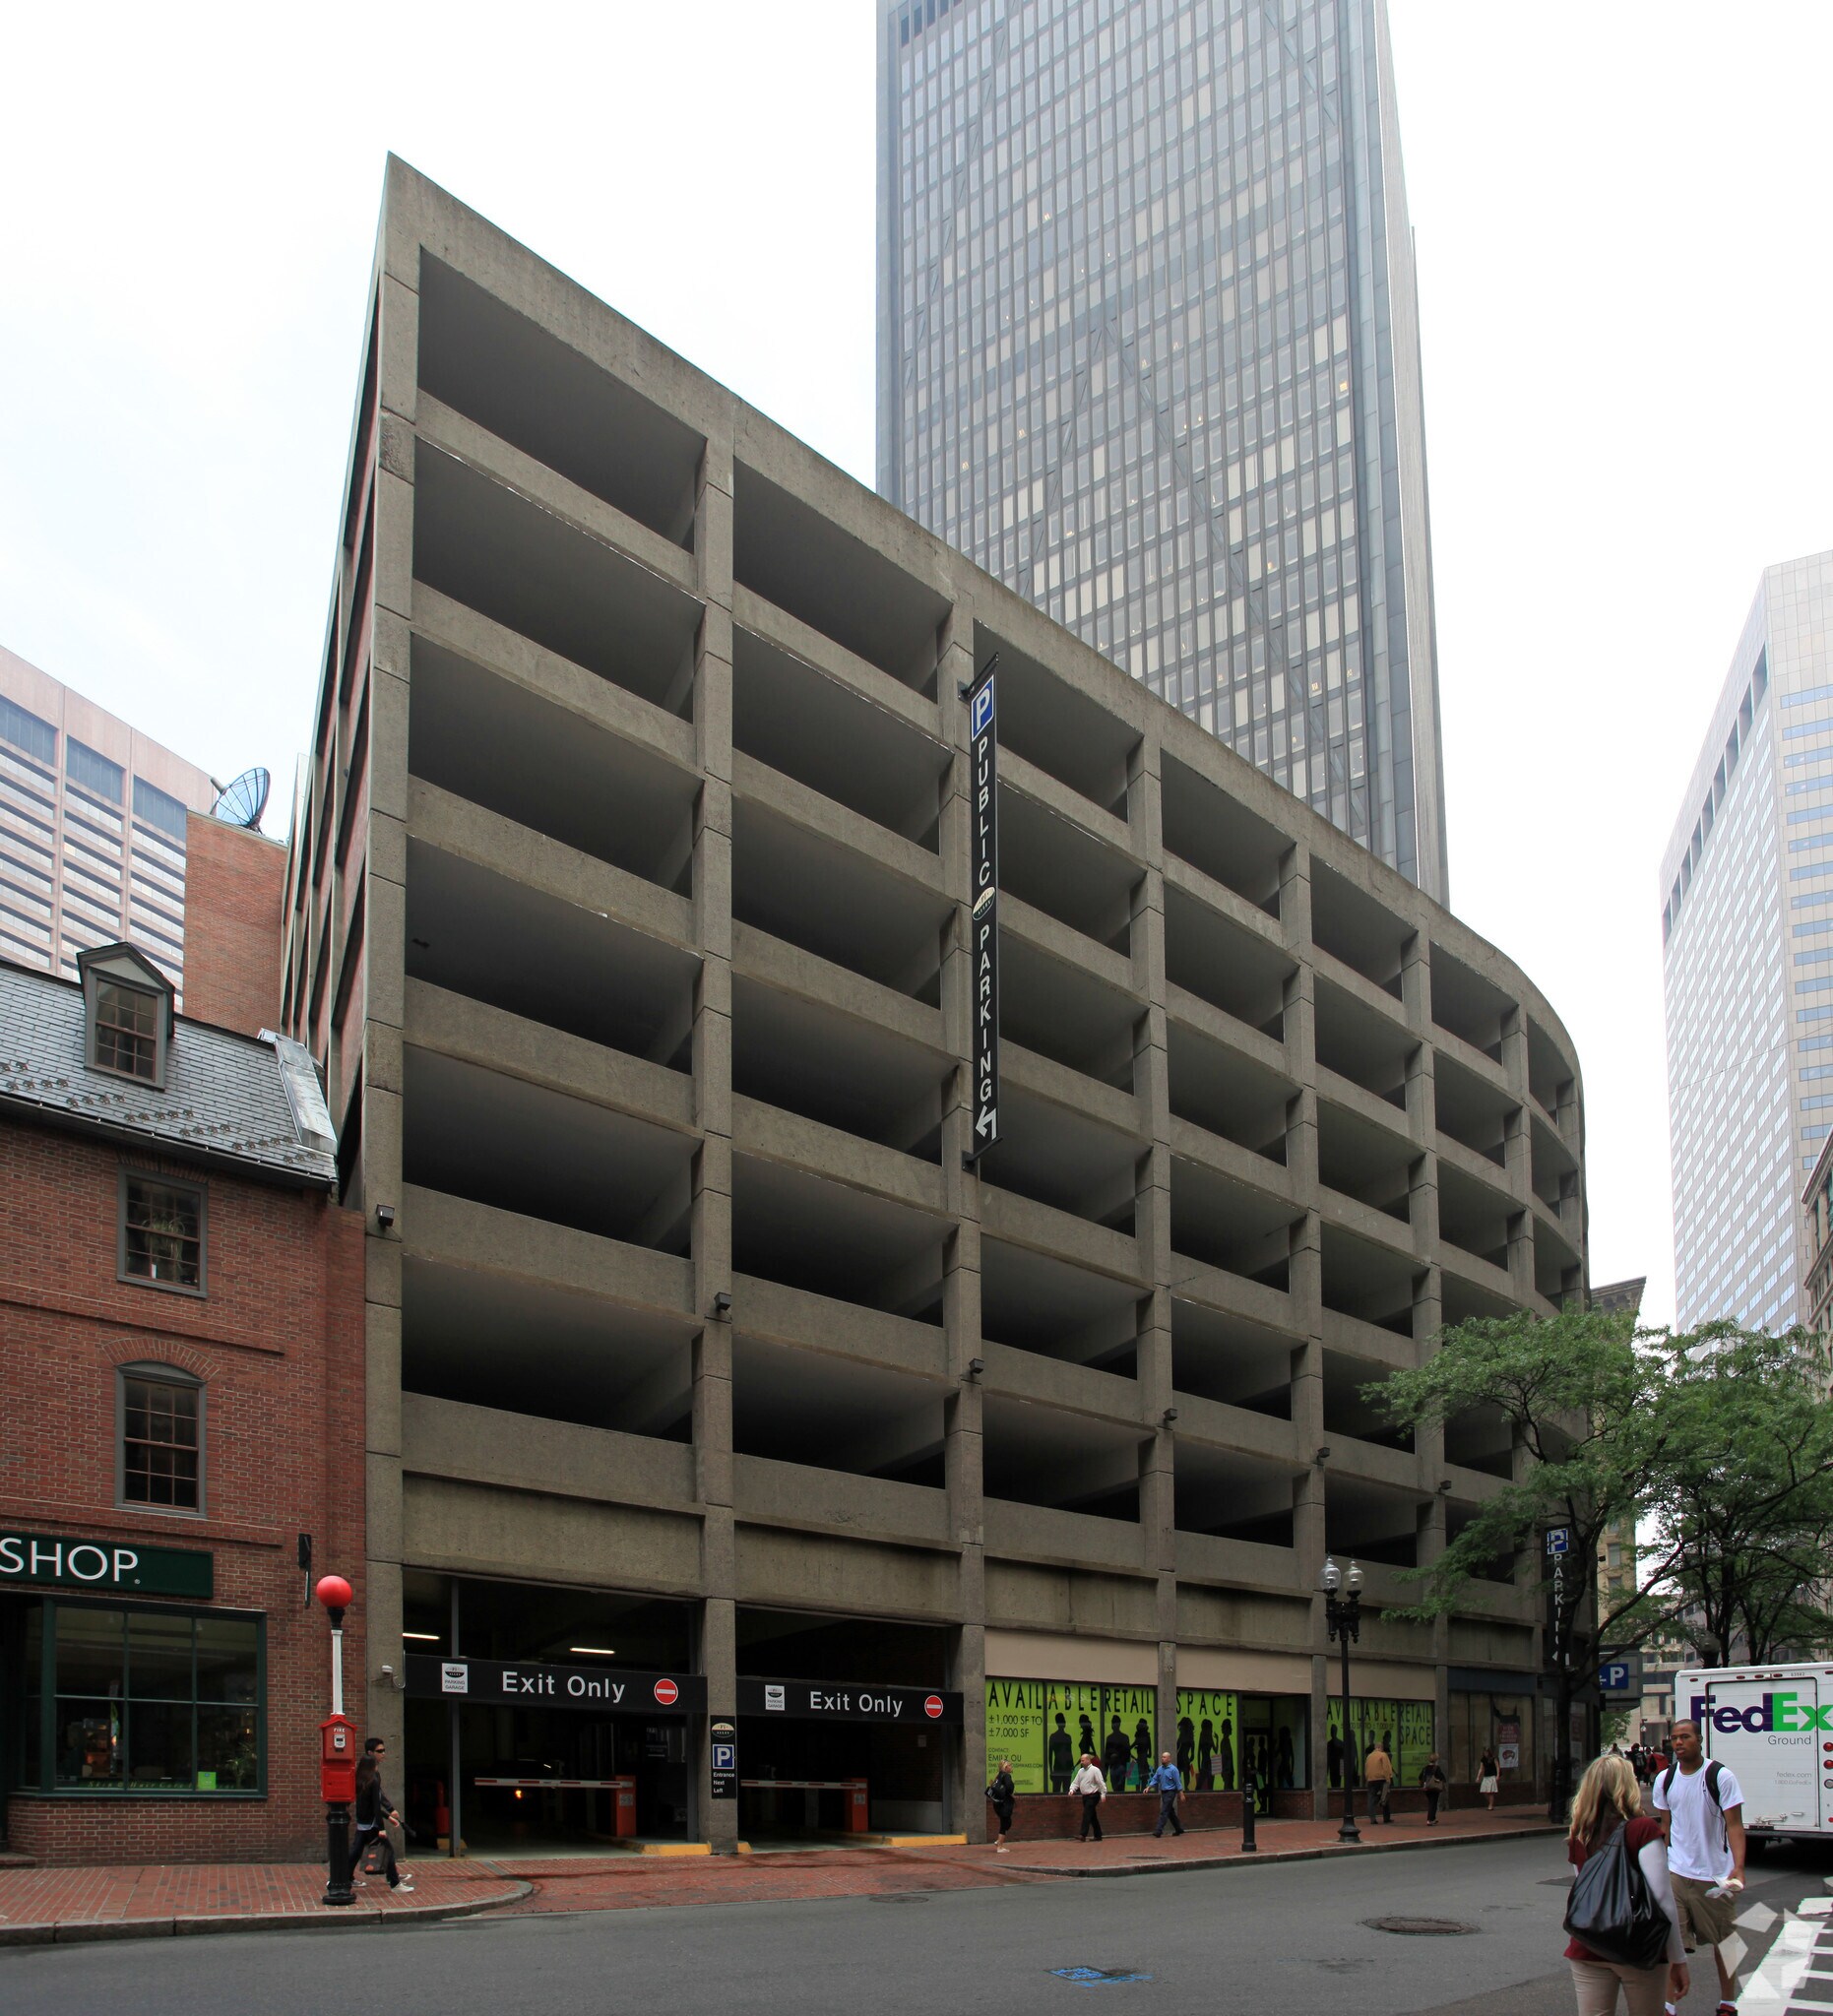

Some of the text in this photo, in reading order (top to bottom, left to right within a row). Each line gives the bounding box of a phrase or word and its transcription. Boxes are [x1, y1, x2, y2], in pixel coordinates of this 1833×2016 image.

[976, 688, 990, 730] P
[978, 735, 990, 886] PUBLIC
[980, 923, 992, 1102] PARKING
[1550, 1530, 1565, 1552] P
[0, 1537, 139, 1583] SHOP
[502, 1670, 626, 1704] Exit Only
[1610, 1667, 1625, 1686] P
[809, 1690, 904, 1718] Exit Only
[988, 1680, 1233, 1717] AVAILABLE RETAIL SPACE
[1326, 1700, 1431, 1723] AVILABLE RETAIL
[1689, 1691, 1833, 1734] FedEx
[1032, 1716, 1043, 1726] TO
[1400, 1726, 1431, 1745] SPACE
[1767, 1734, 1812, 1745] Ground
[717, 1747, 731, 1767] P
